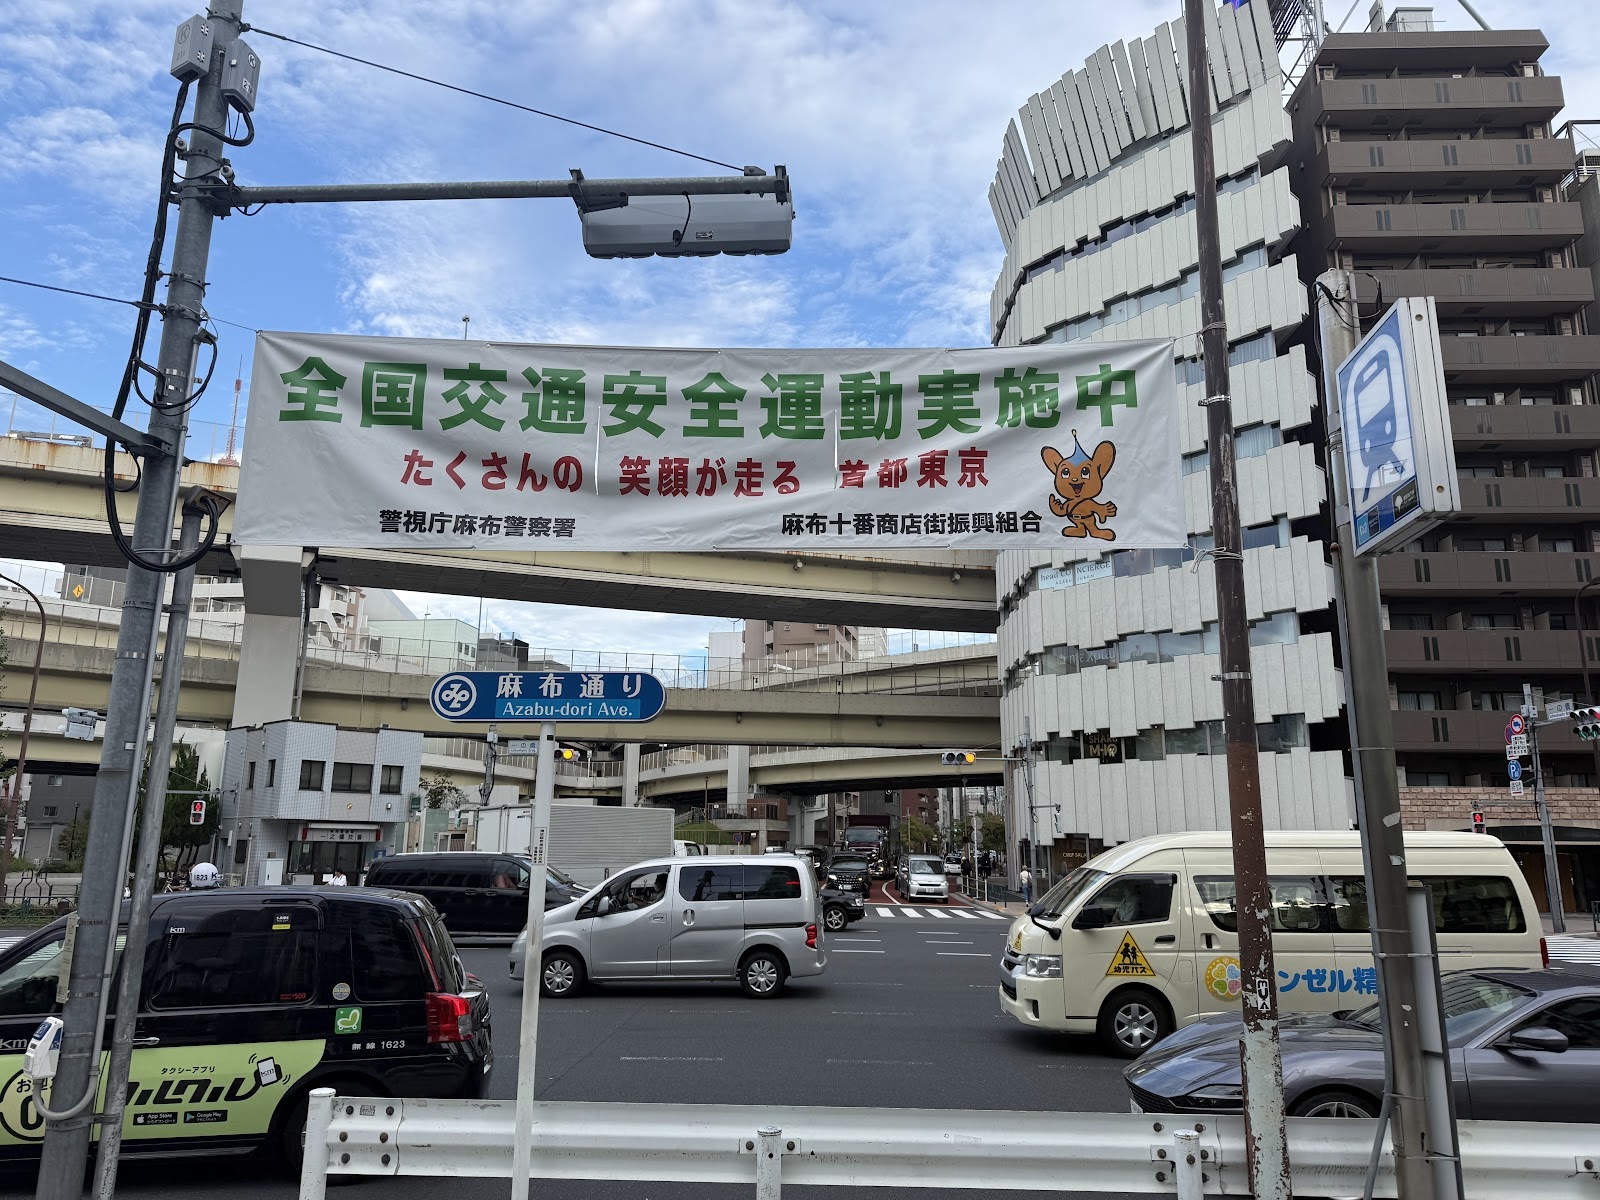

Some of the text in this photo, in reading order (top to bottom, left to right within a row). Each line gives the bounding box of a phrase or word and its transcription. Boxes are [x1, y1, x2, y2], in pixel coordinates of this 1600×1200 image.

[279, 356, 1138, 442] 全国交通安全運動実施中
[400, 446, 989, 498] たくさんの 笑顔が走る 首都東京
[379, 508, 577, 539] 警視庁麻布警察署
[781, 510, 1043, 537] 麻布十番商店街振興組合
[1040, 571, 1059, 583] head
[496, 673, 642, 699] 麻布通り
[502, 702, 633, 717] Azabu-dori Ave.
[1113, 965, 1148, 974] 幼児バス
[380, 1040, 406, 1050] 1623
[161, 1065, 216, 1075] タクシーアプリ
[196, 1112, 213, 1120] Google
